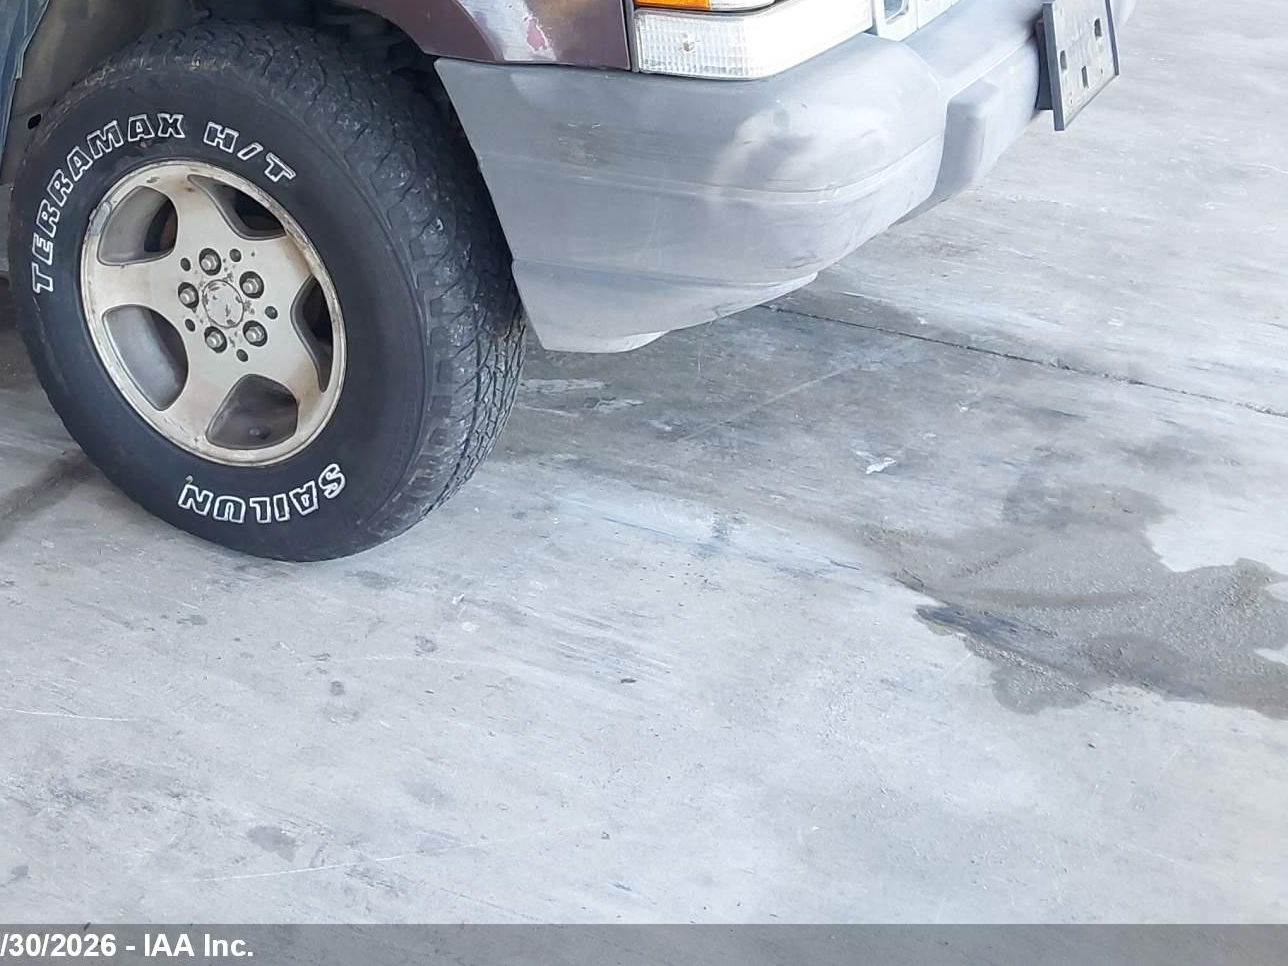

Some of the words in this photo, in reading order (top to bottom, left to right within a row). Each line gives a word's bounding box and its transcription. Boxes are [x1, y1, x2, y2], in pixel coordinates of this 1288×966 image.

[31, 113, 186, 294] TERRAMAX
[203, 121, 297, 183] H/T
[178, 463, 346, 524] SAILUN
